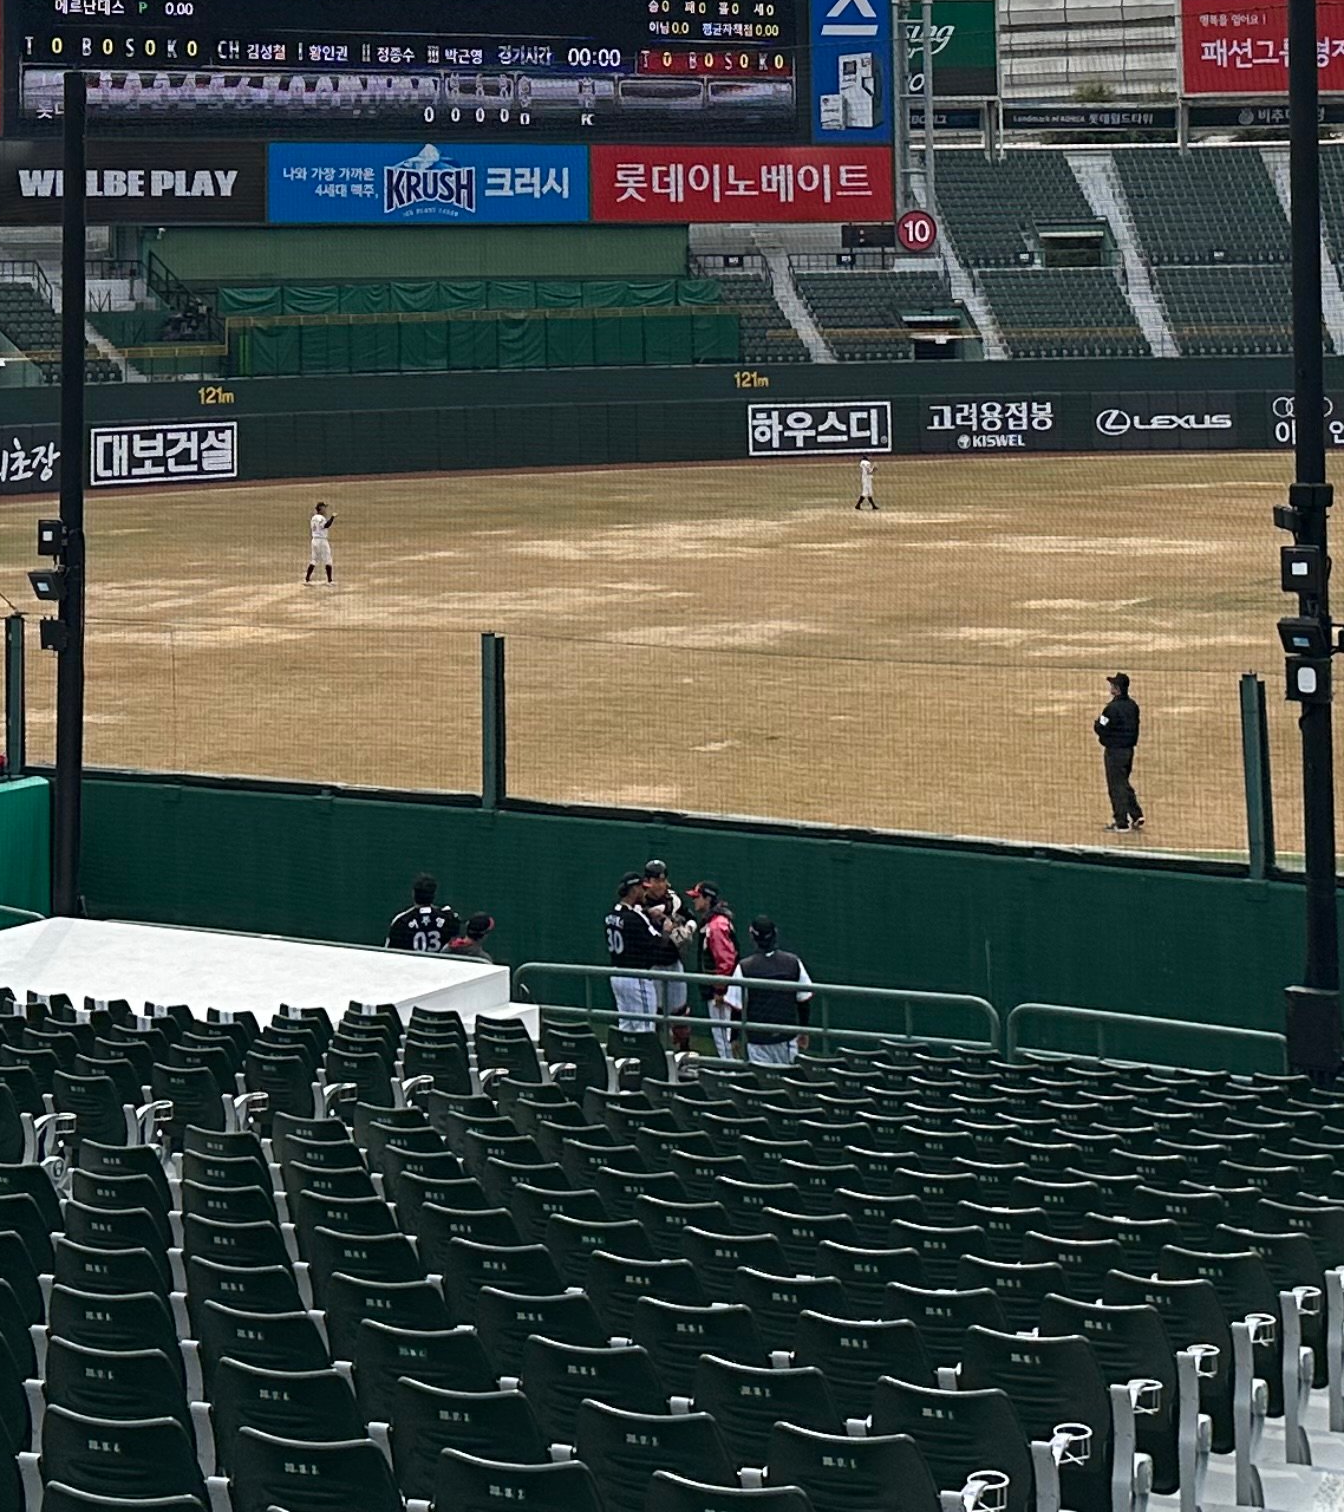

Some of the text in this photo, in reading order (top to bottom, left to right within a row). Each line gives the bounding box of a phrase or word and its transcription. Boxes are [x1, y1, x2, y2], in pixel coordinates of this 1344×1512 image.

[138, 2, 148, 14] P
[165, 2, 194, 16] 0.00
[568, 48, 621, 66] 00:00
[1089, 112, 1154, 125] 롯데월드타워
[18, 169, 238, 198] WILBE PLAY
[283, 167, 307, 182] 나와
[311, 167, 336, 182] 가장
[485, 167, 569, 199] 크러시
[614, 163, 873, 203] 롯데이노베이트
[384, 166, 475, 212] KRUSH
[904, 220, 930, 242] 10
[733, 370, 769, 388] 121m
[198, 386, 235, 405] 121m
[926, 401, 1054, 432] 고려용접봉
[1133, 414, 1232, 429] LEXUS
[751, 409, 880, 448] 하우스디
[972, 434, 1026, 448] KISWEL
[96, 429, 233, 478] 대보건설
